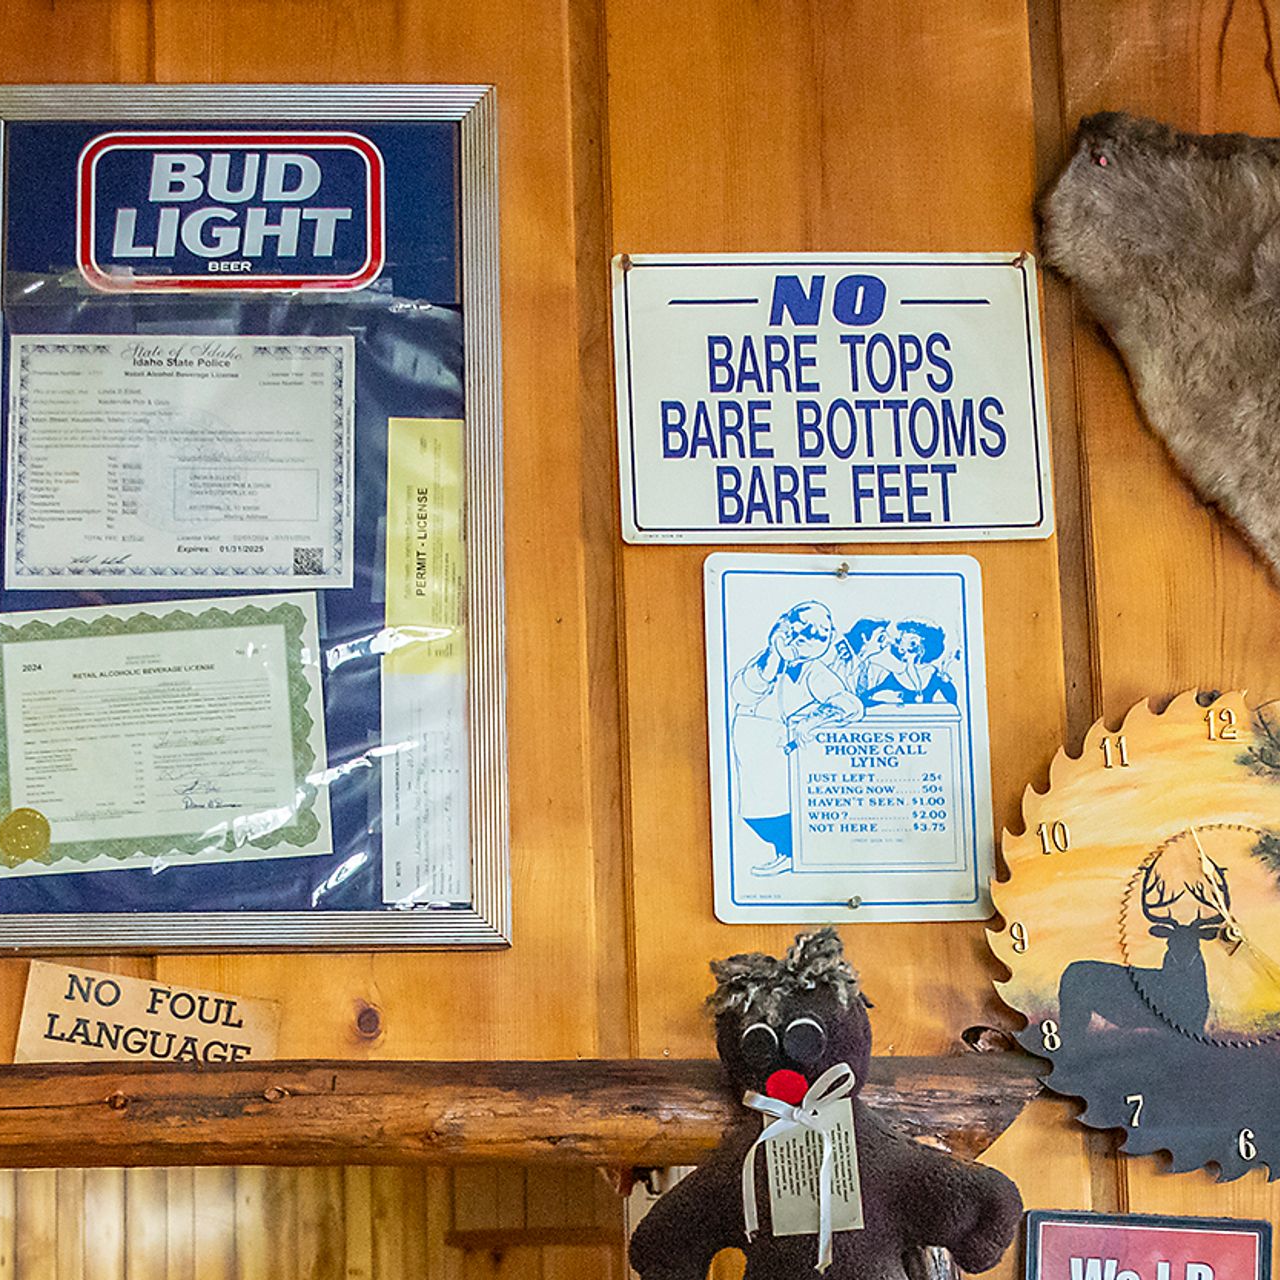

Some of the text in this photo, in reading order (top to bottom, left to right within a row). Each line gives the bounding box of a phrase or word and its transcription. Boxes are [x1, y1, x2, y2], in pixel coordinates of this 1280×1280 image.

[149, 152, 322, 203] BUD
[112, 207, 353, 258] LIGHT
[208, 260, 251, 273] BEER
[768, 274, 887, 327] NO
[133, 358, 231, 368] Idaho State Police
[707, 332, 953, 394] BARE TOPS
[661, 397, 1007, 459] BARE BOTTOMS
[715, 463, 957, 524] BARE FEET
[416, 487, 427, 597] PERMIT LICENSE
[22, 663, 42, 673] 2024
[815, 731, 932, 744] CHARGES FOR
[1204, 709, 1237, 740] 12
[825, 744, 927, 756] PHONE CALL
[850, 756, 899, 768] LYING
[1099, 737, 1130, 768] 11
[807, 773, 838, 783] JUST
[807, 785, 863, 796] LEAVING
[866, 785, 895, 795] NOW
[807, 797, 864, 807] HAVEN'T
[912, 796, 945, 807] $1.00
[808, 810, 947, 821] WHO? $2.00
[808, 821, 946, 833] NOT HERE $3.75
[1037, 820, 1071, 854] 10
[1010, 922, 1029, 953] 9
[64, 974, 243, 1029] NO FOUL
[43, 1013, 252, 1063] LANGUAGE
[1042, 1020, 1061, 1052] 8
[1126, 1094, 1143, 1127] 7
[1238, 1128, 1257, 1161] 6
